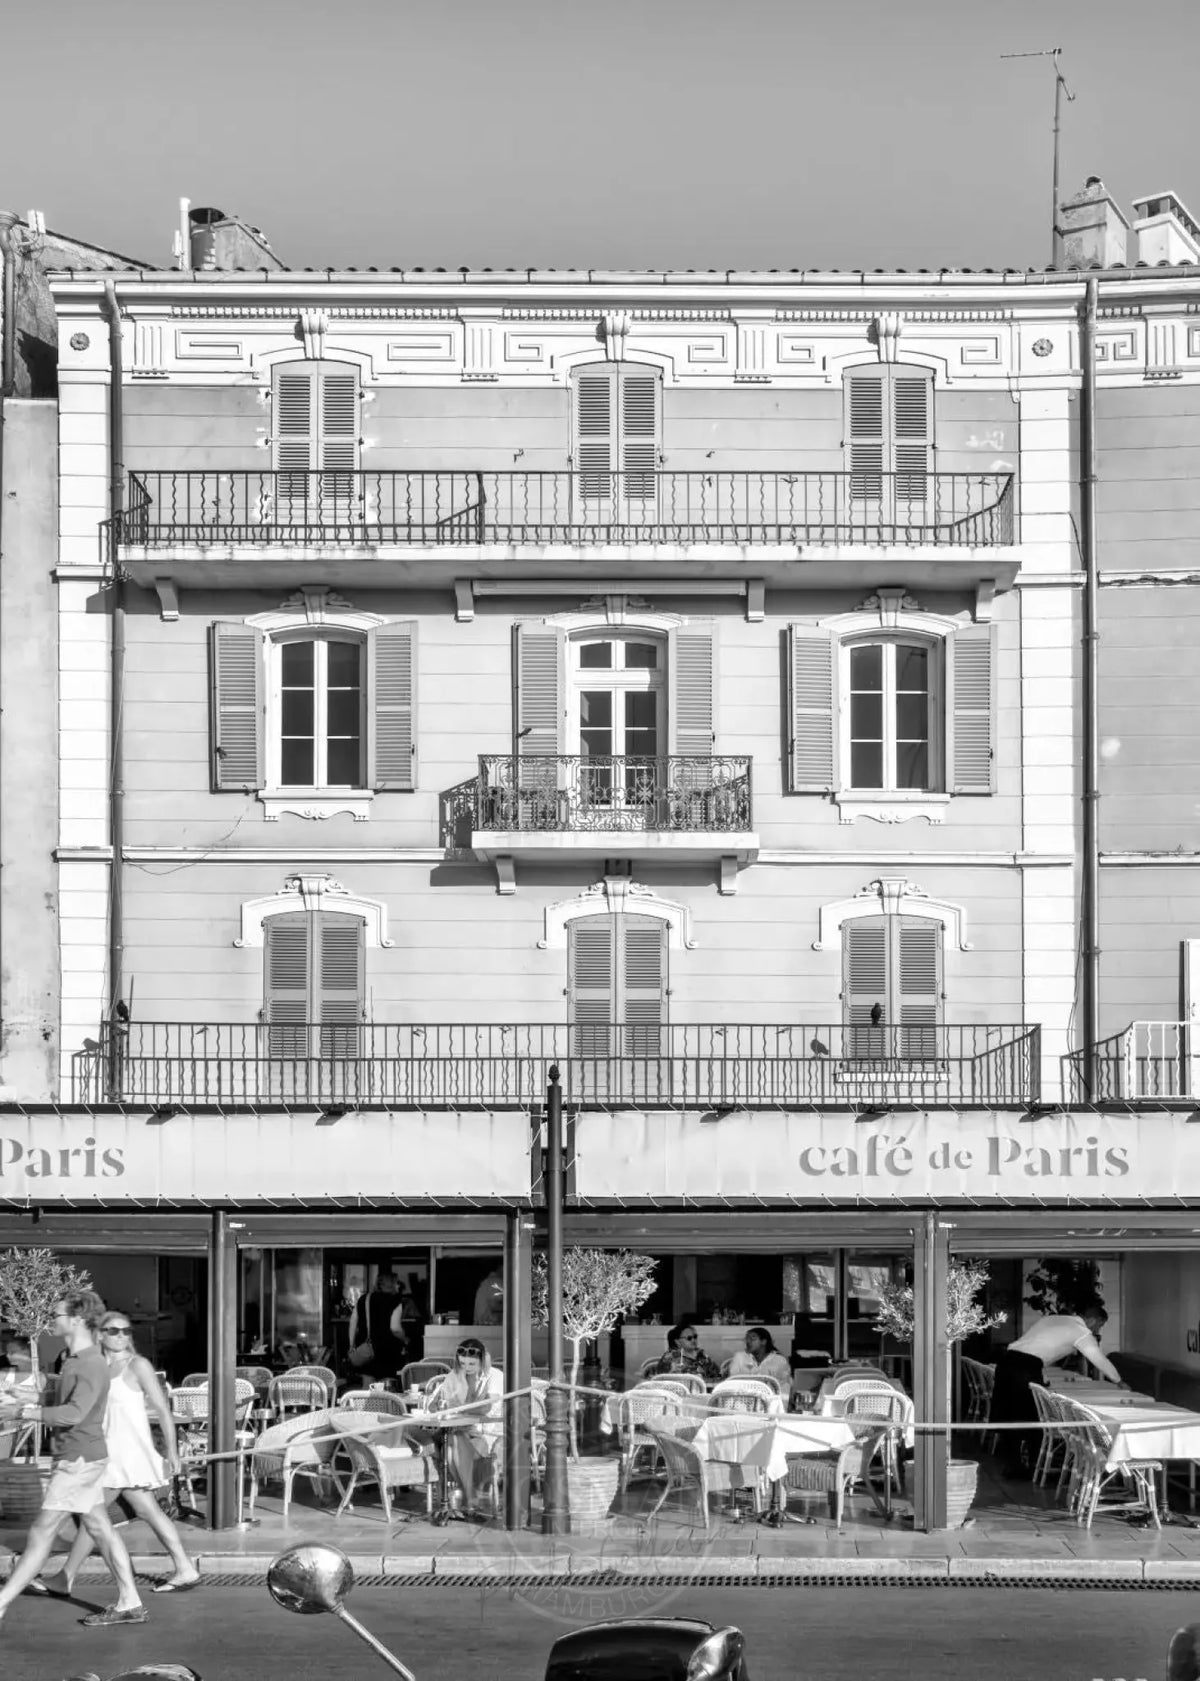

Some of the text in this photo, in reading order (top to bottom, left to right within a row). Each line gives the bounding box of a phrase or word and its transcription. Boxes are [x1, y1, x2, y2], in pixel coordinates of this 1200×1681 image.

[0, 1137, 125, 1177] Paris
[799, 1134, 1130, 1177] café de Paris
